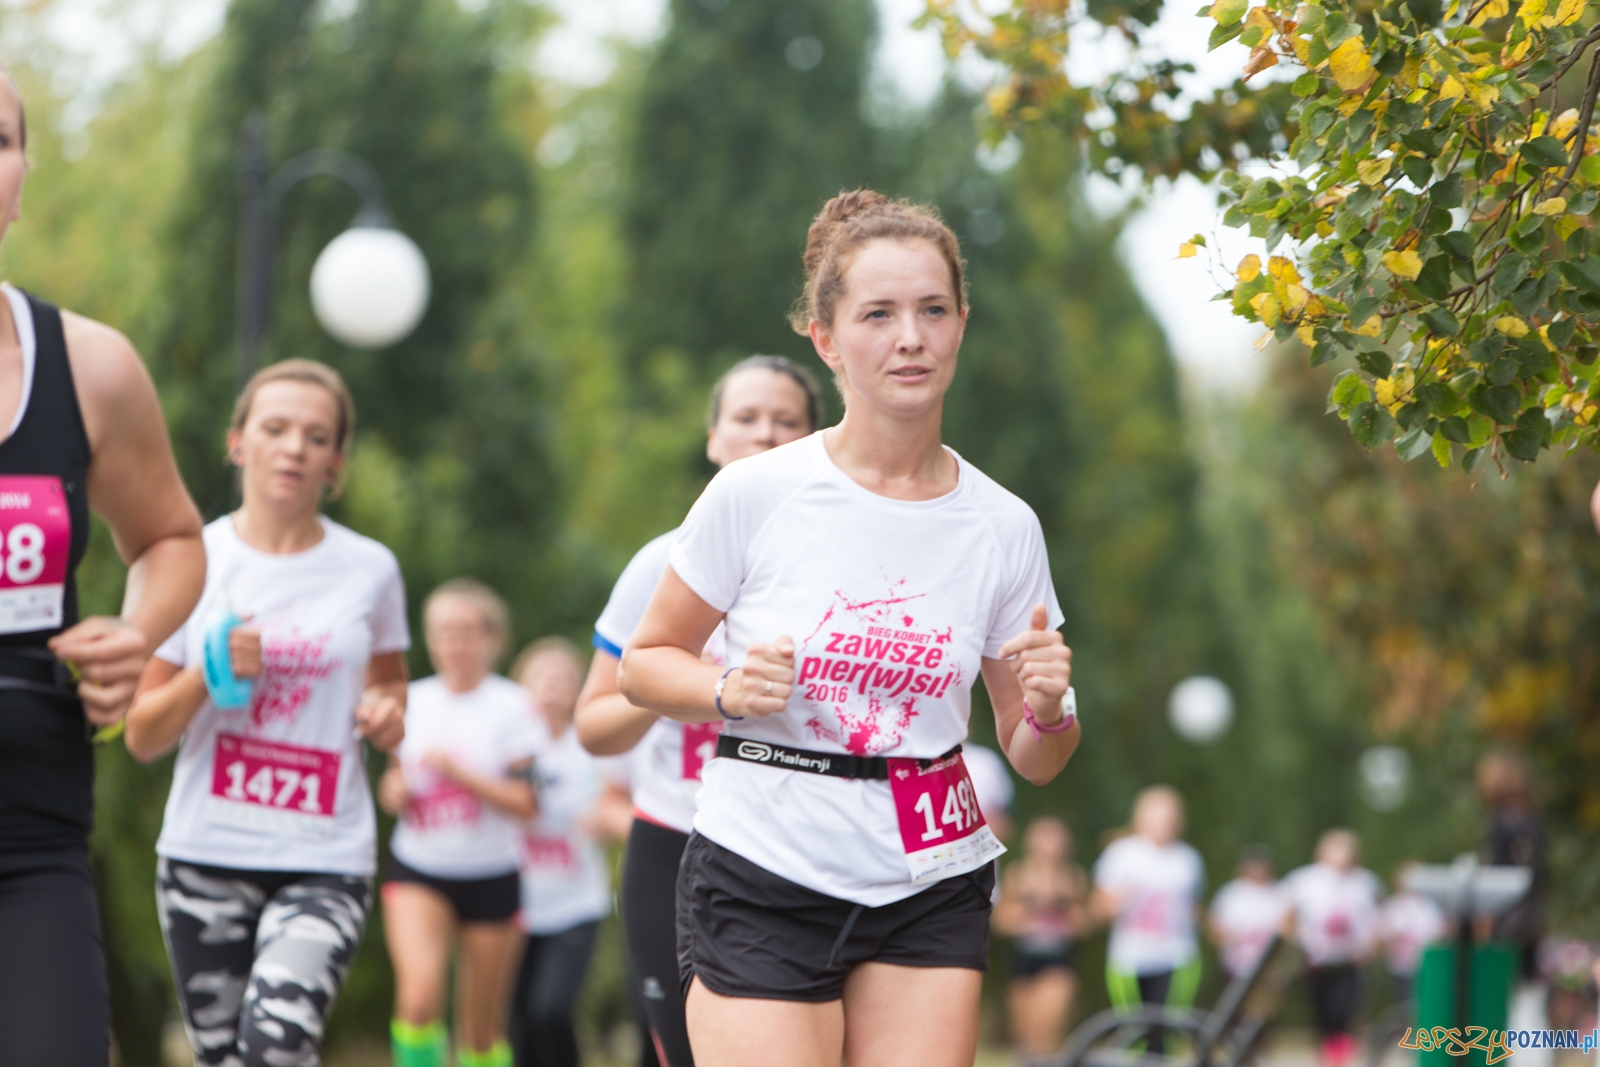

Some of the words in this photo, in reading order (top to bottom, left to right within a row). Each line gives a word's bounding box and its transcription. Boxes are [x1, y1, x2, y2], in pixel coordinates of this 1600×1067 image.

[0, 522, 46, 585] 8
[824, 632, 943, 669] zawsze
[867, 626, 892, 639] BIEG
[893, 629, 932, 645] KOBIET
[804, 684, 848, 703] 2016
[773, 749, 831, 773] Kalenji
[224, 760, 323, 814] 1471
[914, 776, 979, 842] 1493
